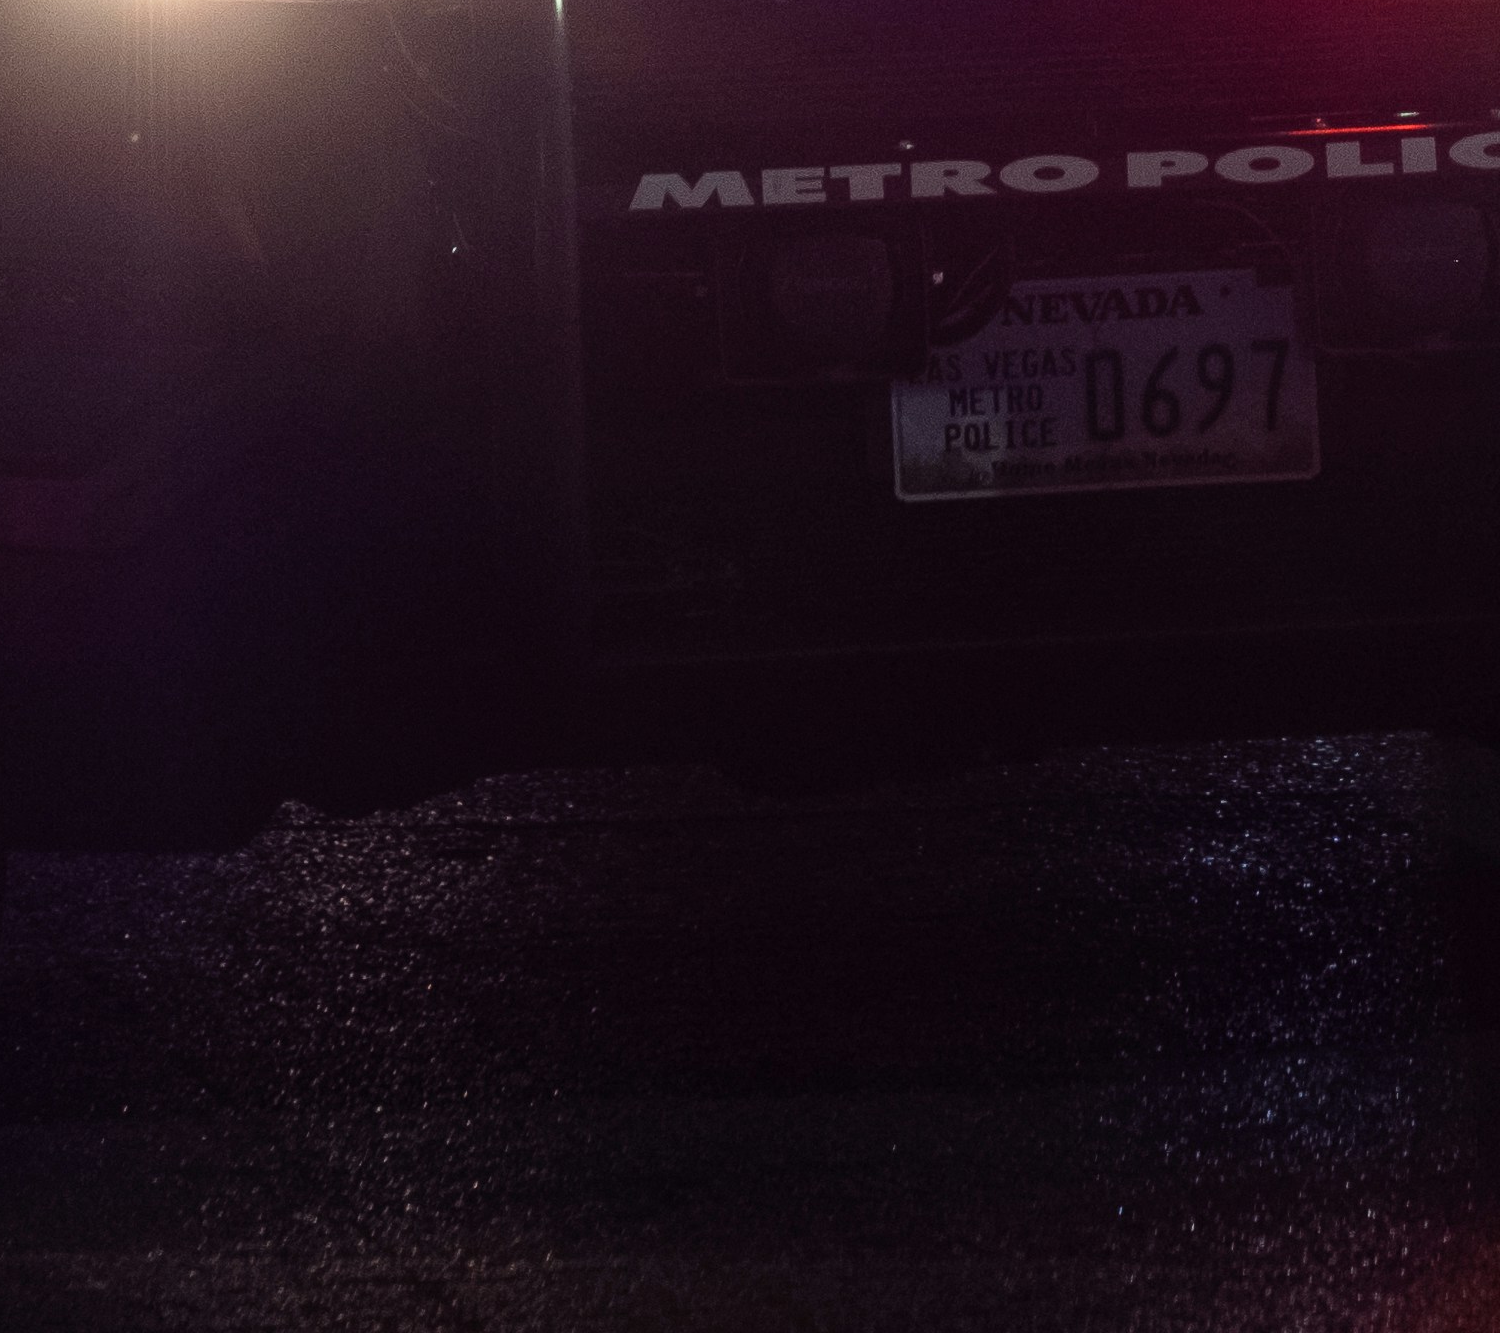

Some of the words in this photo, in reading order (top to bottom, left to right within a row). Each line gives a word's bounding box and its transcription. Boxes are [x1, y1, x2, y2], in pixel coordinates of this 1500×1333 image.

[629, 153, 1100, 211] METRO
[1000, 284, 1204, 328] NEVADA
[983, 347, 1077, 381] VEGAS
[949, 384, 1044, 417] METRO
[1084, 337, 1291, 442] 0697
[944, 416, 1058, 454] POLICE
